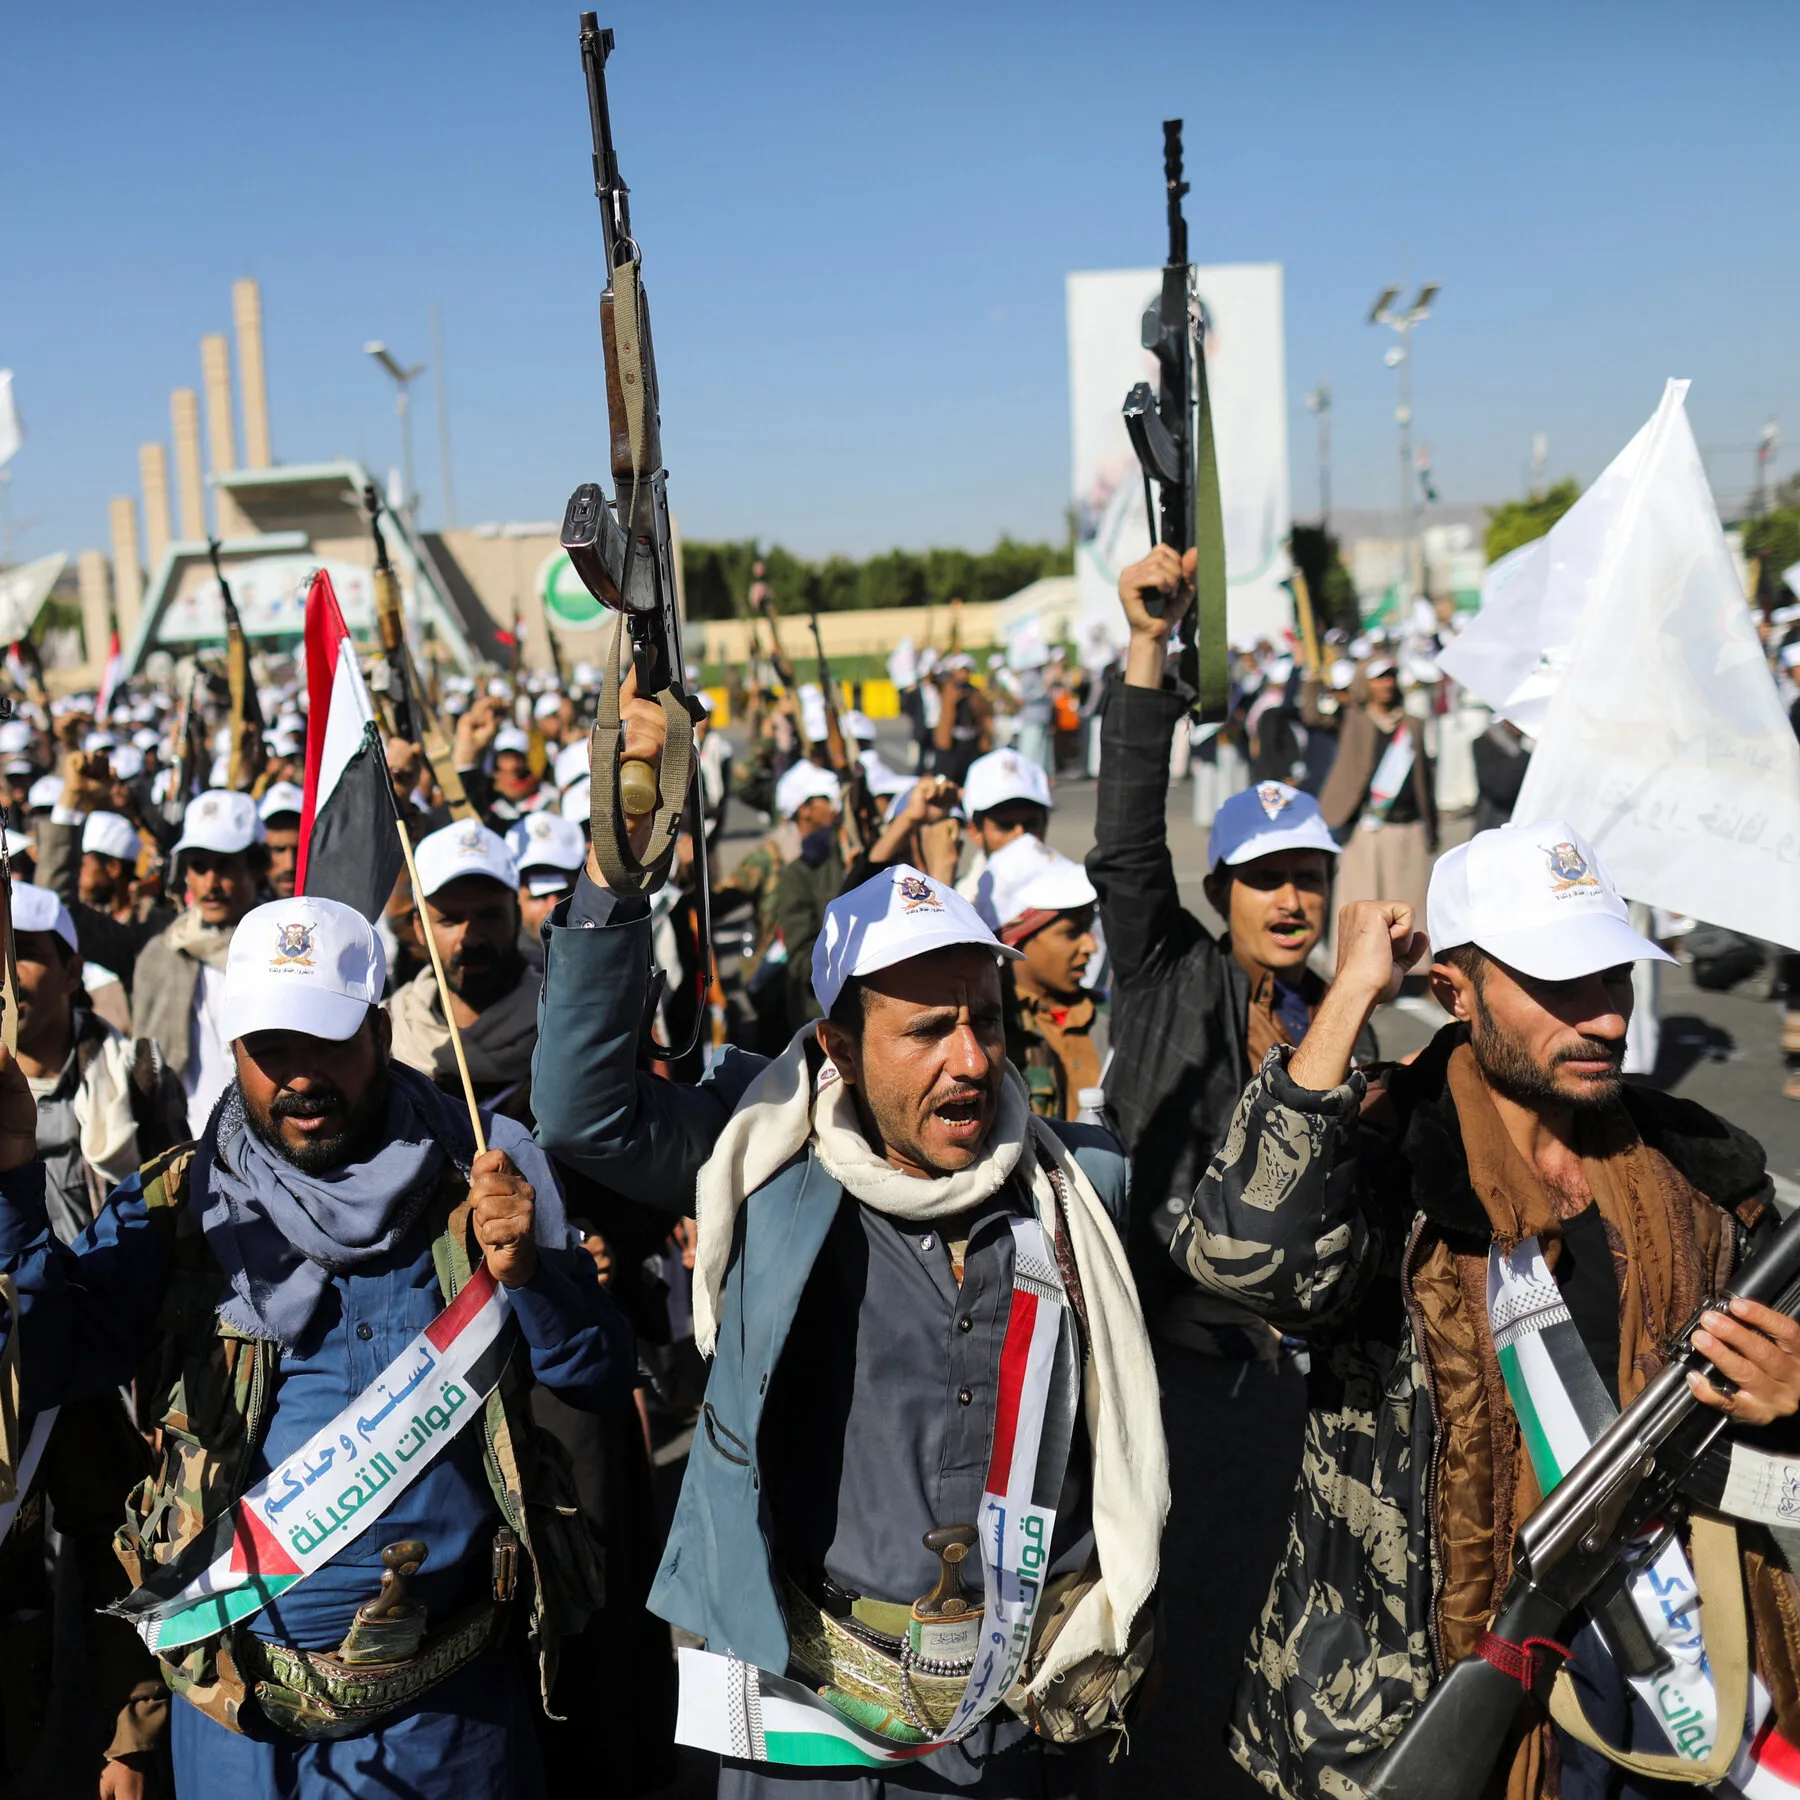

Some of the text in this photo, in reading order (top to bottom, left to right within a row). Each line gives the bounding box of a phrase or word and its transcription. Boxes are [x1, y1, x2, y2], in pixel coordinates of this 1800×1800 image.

[357, 1346, 436, 1442] لستم
[289, 1381, 467, 1555] قوات التعبئة
[944, 1502, 1008, 1739] لستم وحدك
[1016, 1515, 1046, 1616] قوات
